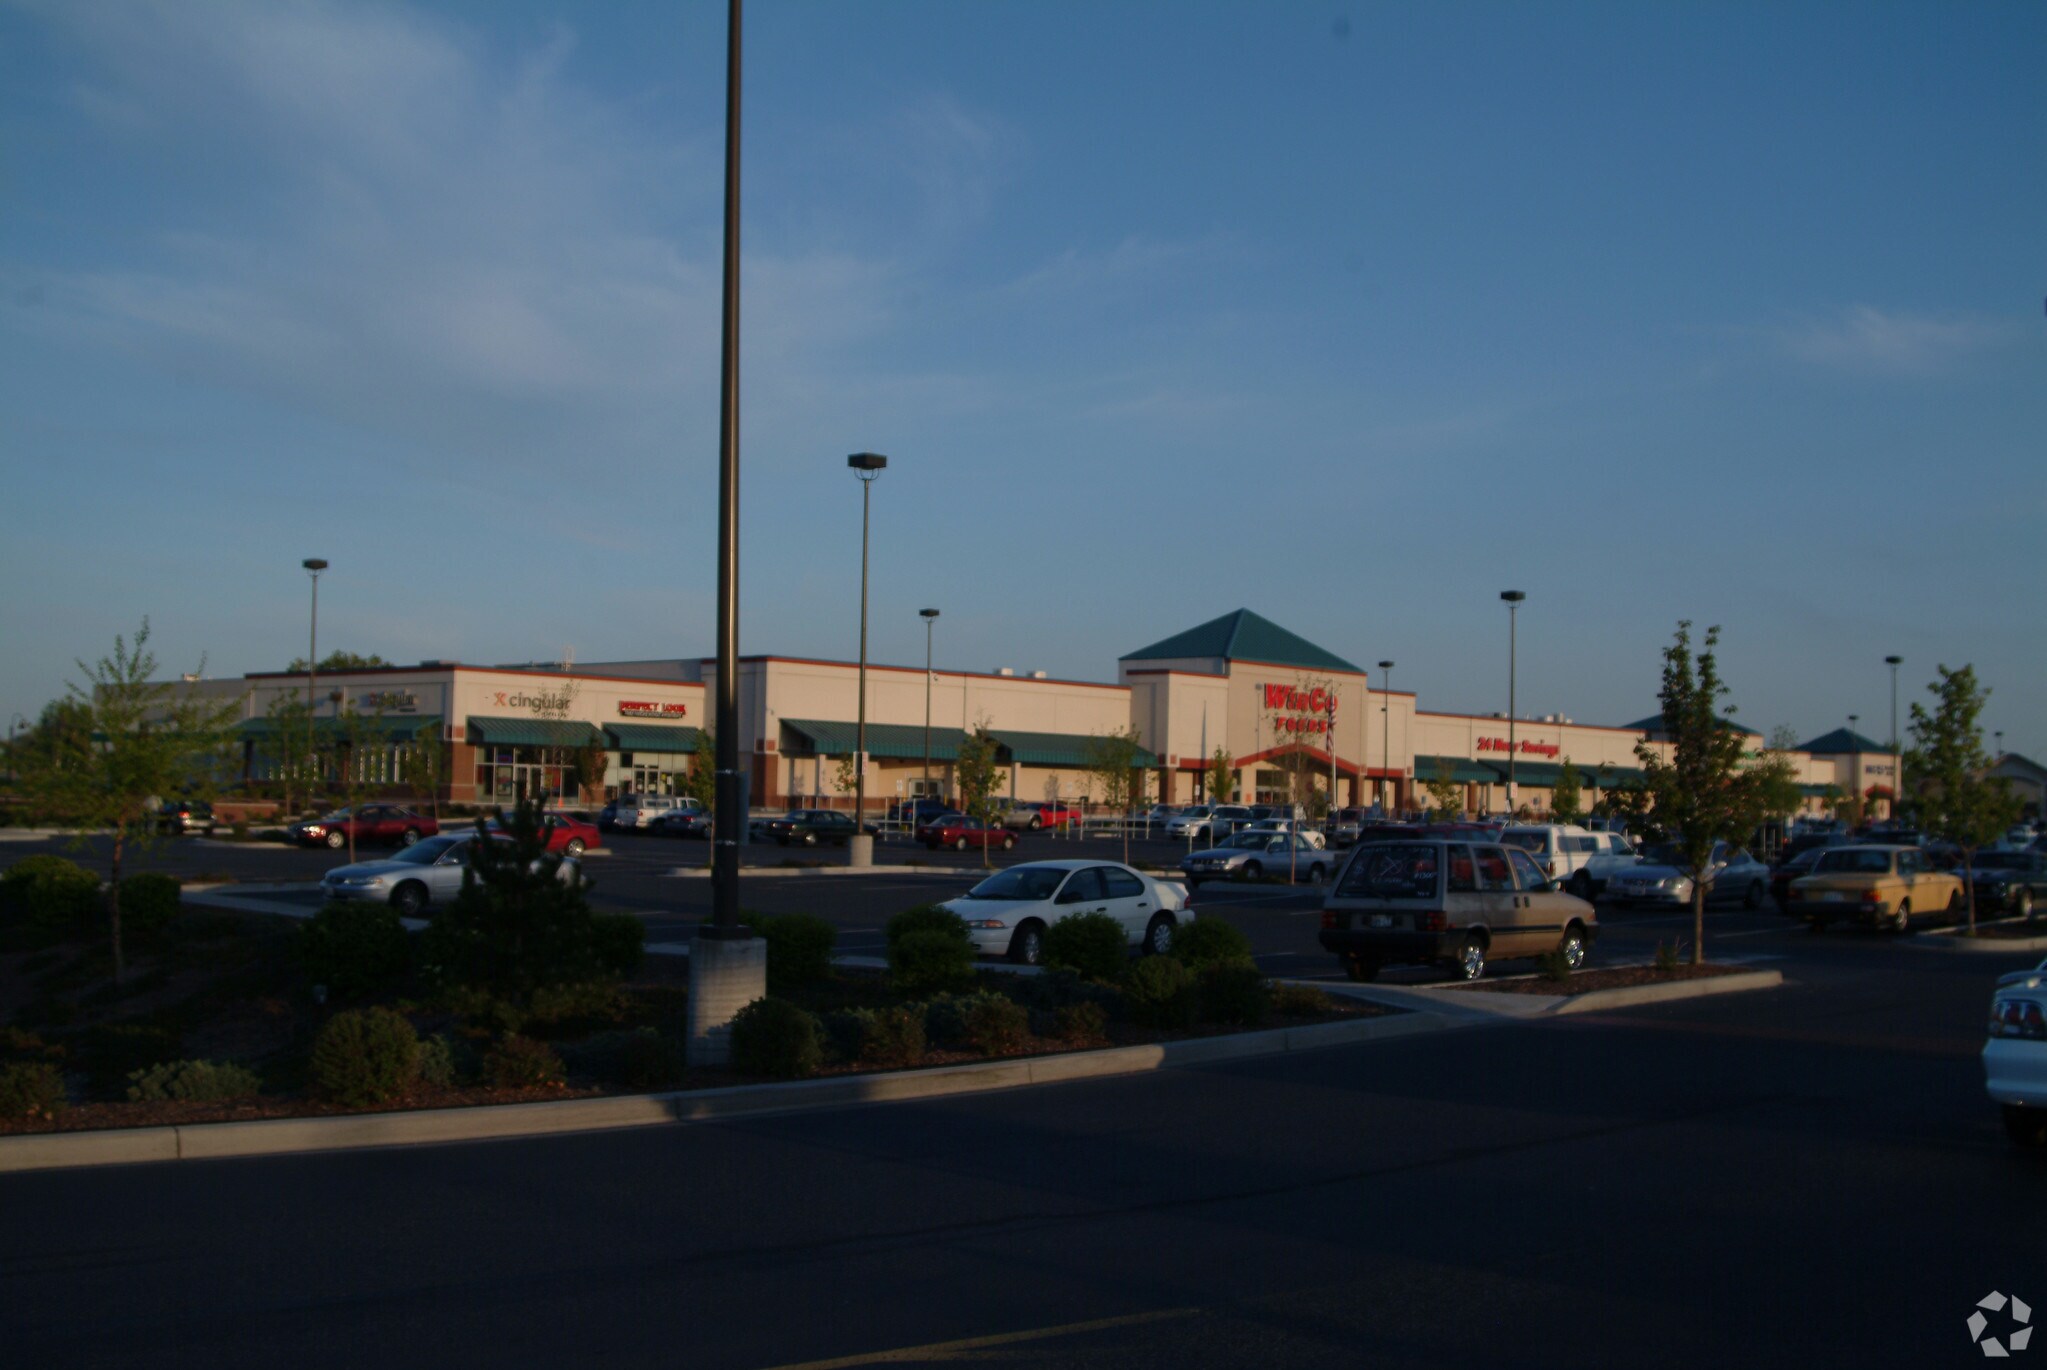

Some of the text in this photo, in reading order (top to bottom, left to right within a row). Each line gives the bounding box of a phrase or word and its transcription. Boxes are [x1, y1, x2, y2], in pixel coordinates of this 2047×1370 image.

[509, 692, 571, 713] cingular
[1264, 683, 1338, 713] WinCo
[1477, 737, 1492, 751] 24
